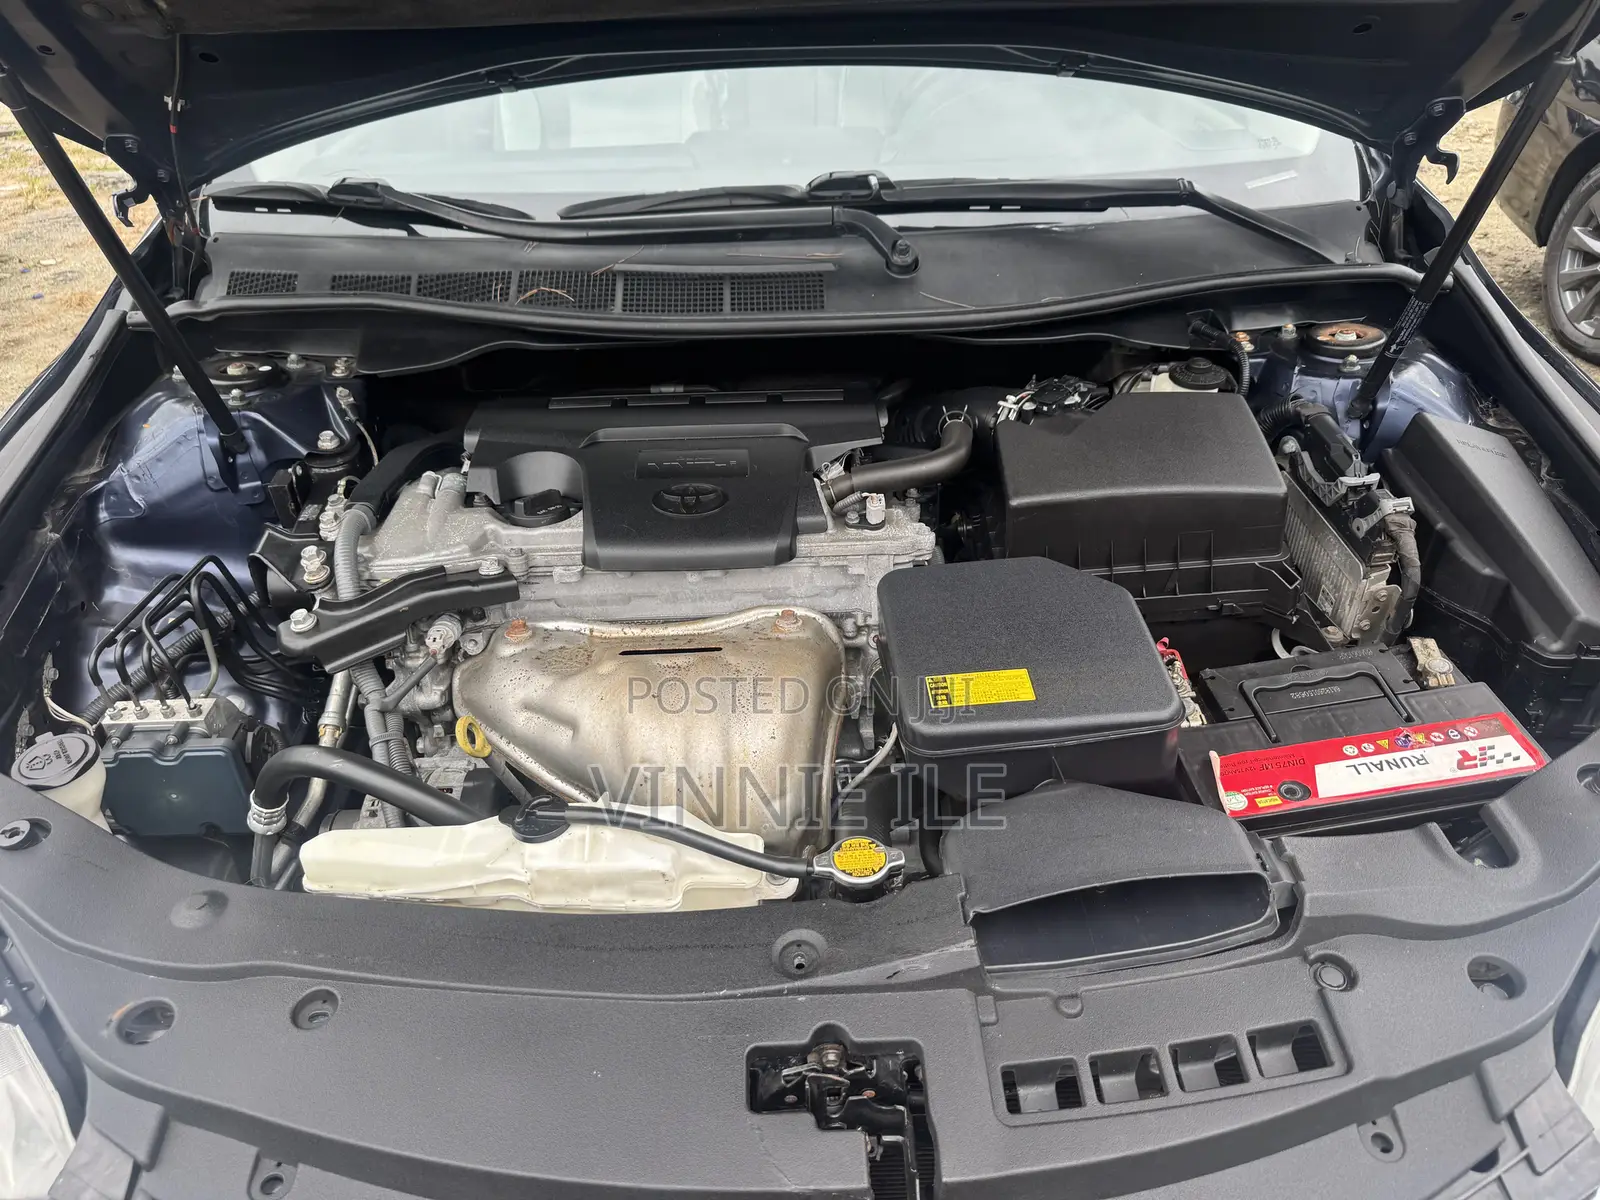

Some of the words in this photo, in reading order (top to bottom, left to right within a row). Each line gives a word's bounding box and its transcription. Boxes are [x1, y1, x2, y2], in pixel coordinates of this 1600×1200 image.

[1259, 762, 1274, 772] MF
[1276, 757, 1306, 770] DIN75
[1346, 753, 1430, 775] RUNALL
